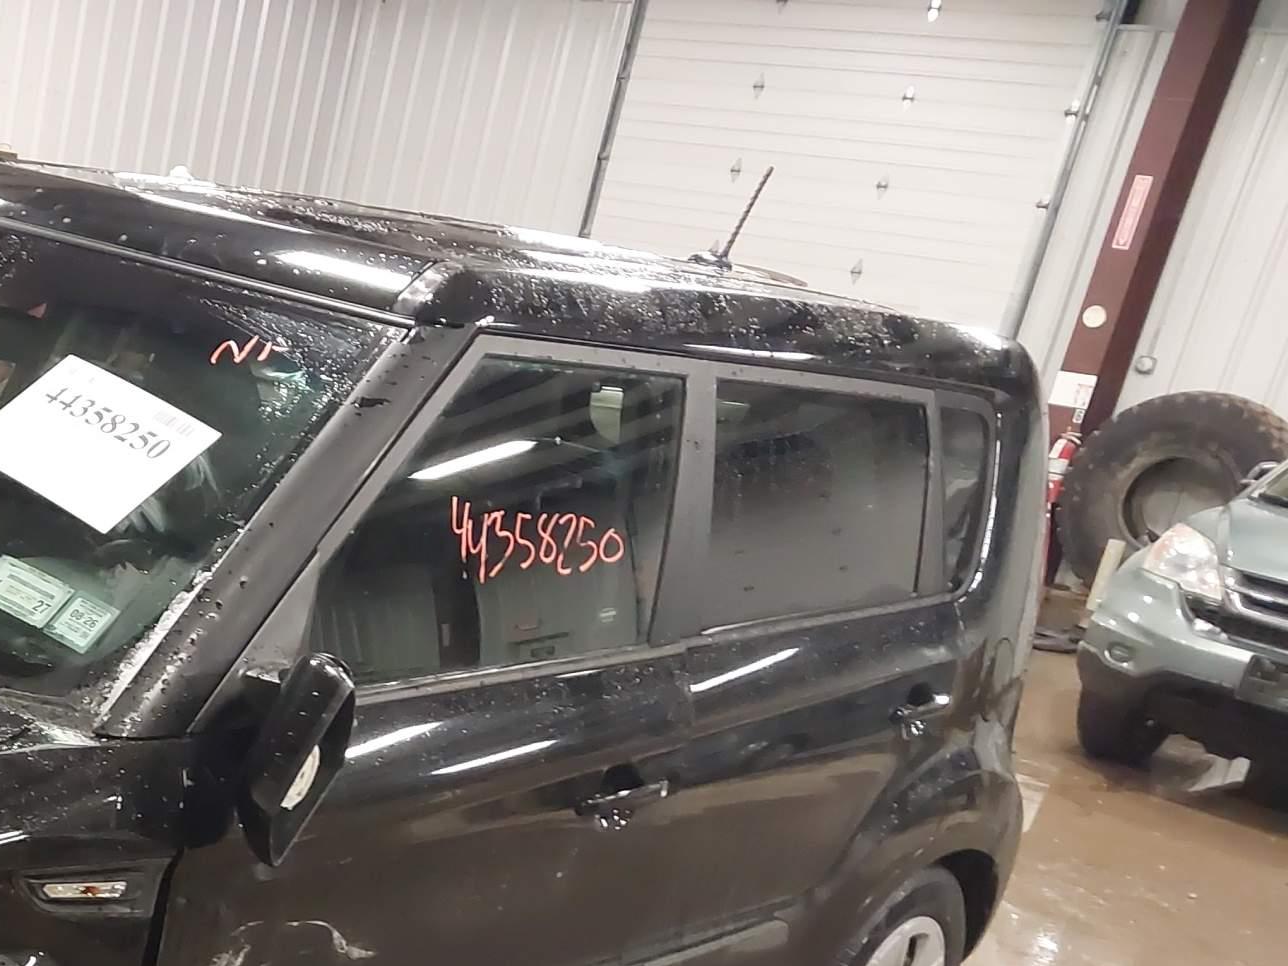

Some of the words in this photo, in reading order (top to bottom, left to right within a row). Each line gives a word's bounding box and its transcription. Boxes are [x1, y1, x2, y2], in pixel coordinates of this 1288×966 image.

[44, 386, 171, 459] 44358250
[450, 495, 625, 585] 44358250
[31, 599, 52, 615] 27
